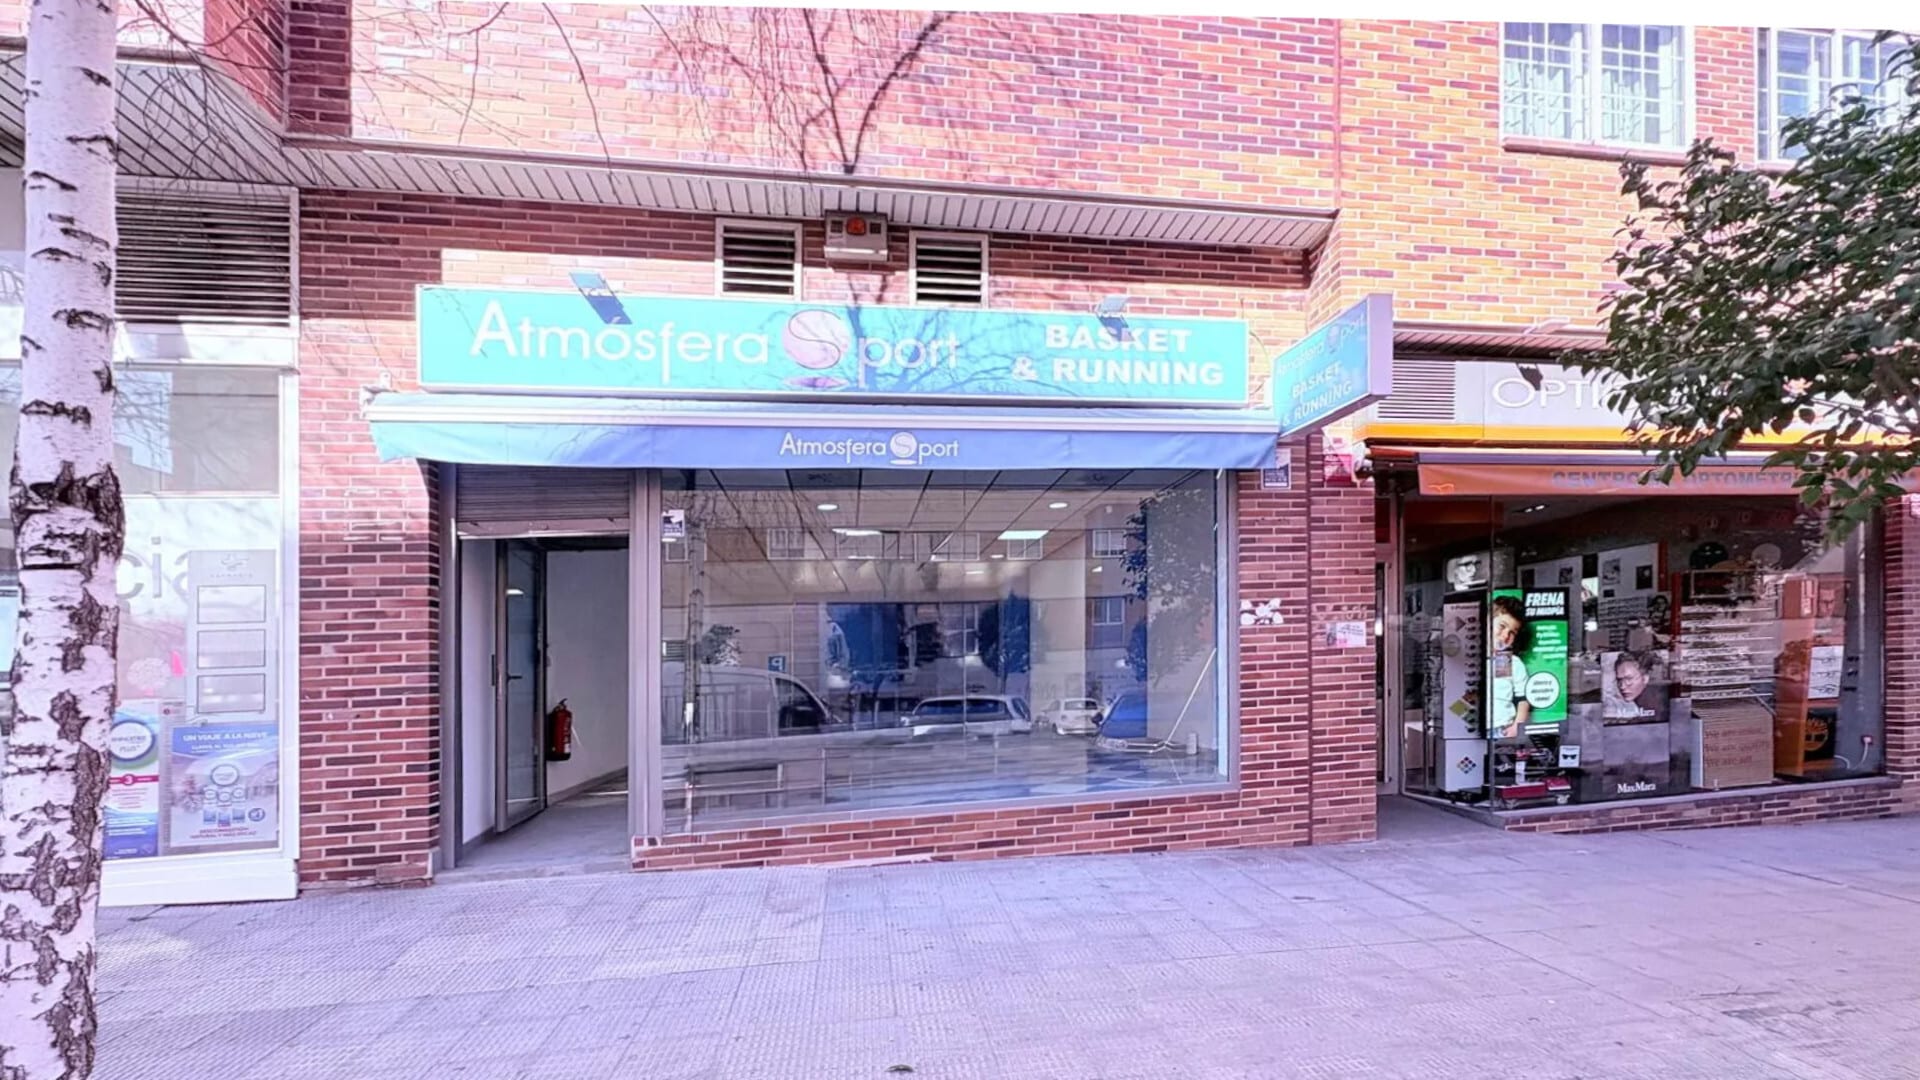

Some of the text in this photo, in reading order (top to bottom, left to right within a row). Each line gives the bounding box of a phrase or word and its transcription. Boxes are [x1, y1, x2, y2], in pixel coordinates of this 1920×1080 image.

[1045, 324, 1192, 354] BASKET
[1011, 357, 1224, 386] & RUNNING
[1292, 361, 1342, 398] BASKET
[1295, 380, 1353, 420] RUNNING
[780, 431, 887, 464] Atmosfera
[1525, 591, 1565, 607] FRENA
[1616, 781, 1657, 794] MaxMara
